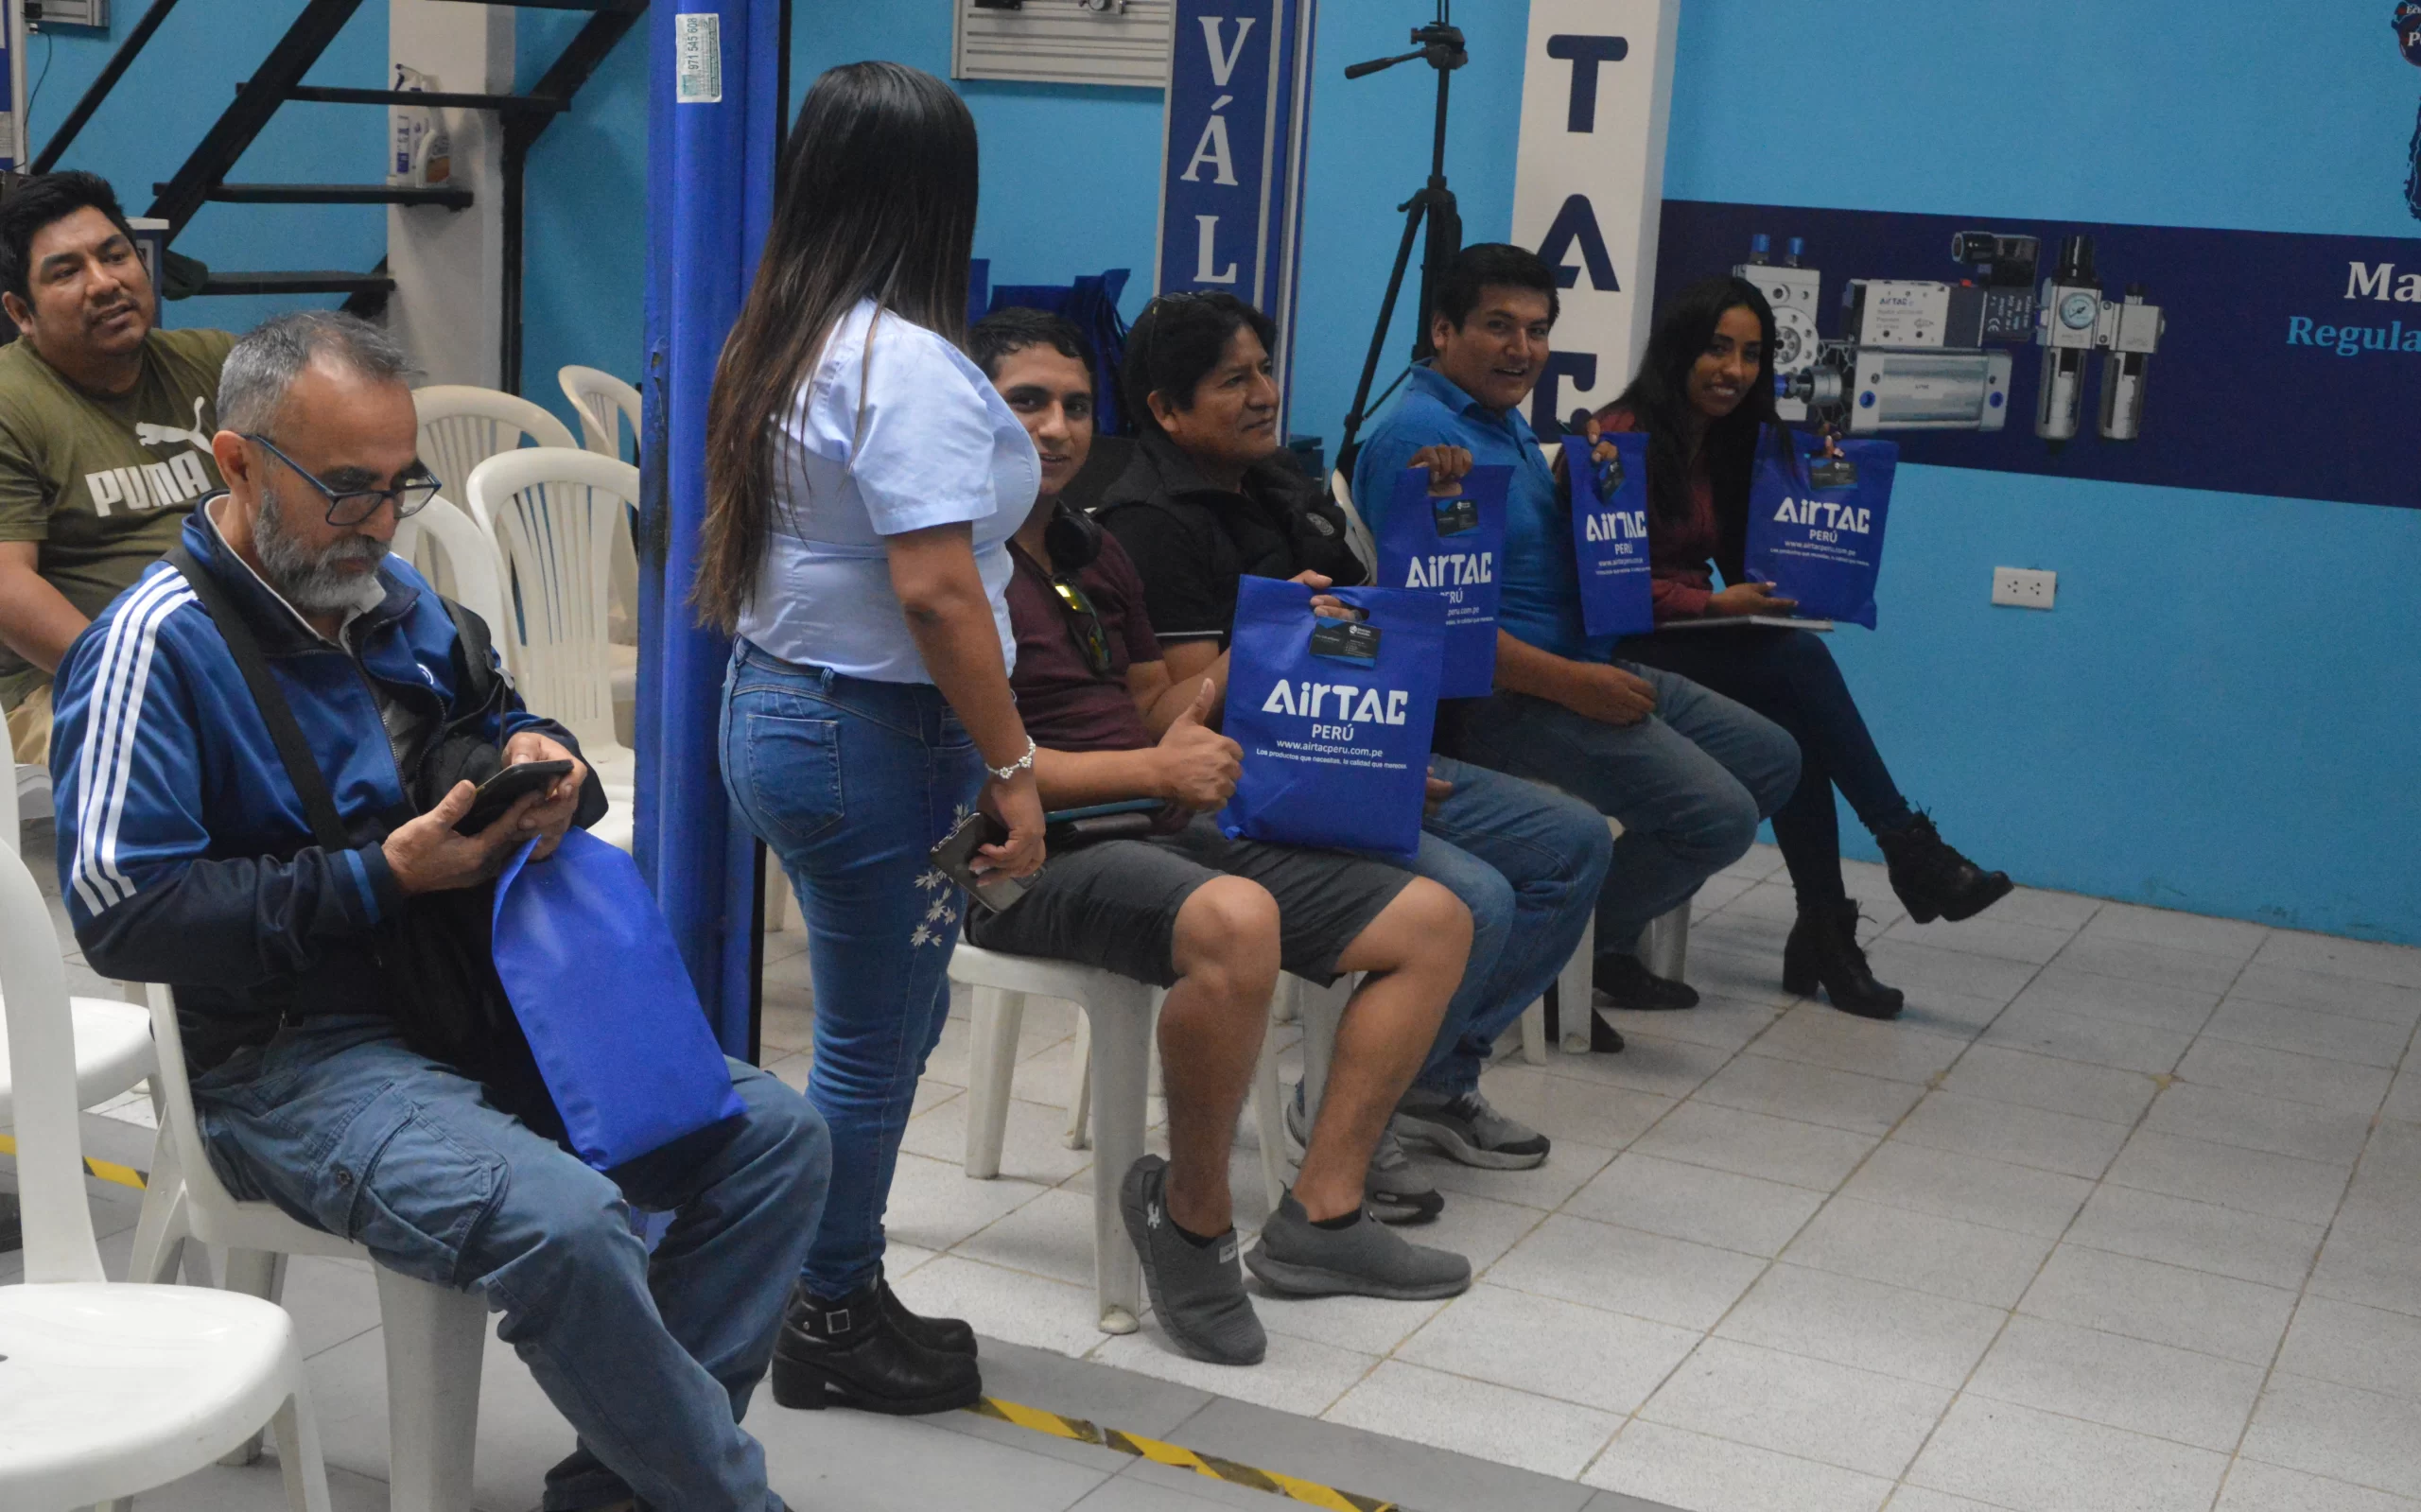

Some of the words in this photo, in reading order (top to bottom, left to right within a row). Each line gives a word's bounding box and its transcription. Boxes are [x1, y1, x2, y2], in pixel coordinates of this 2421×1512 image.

[687, 17, 698, 33] 608
[688, 36, 699, 52] 545
[688, 56, 699, 70] 971
[84, 450, 212, 517] PUMA
[1809, 530, 1838, 544] PERÚ
[1312, 723, 1354, 741] PERÚ
[1268, 751, 1299, 760] productos
[1277, 739, 1384, 758] www.airtacperu.com.pe
